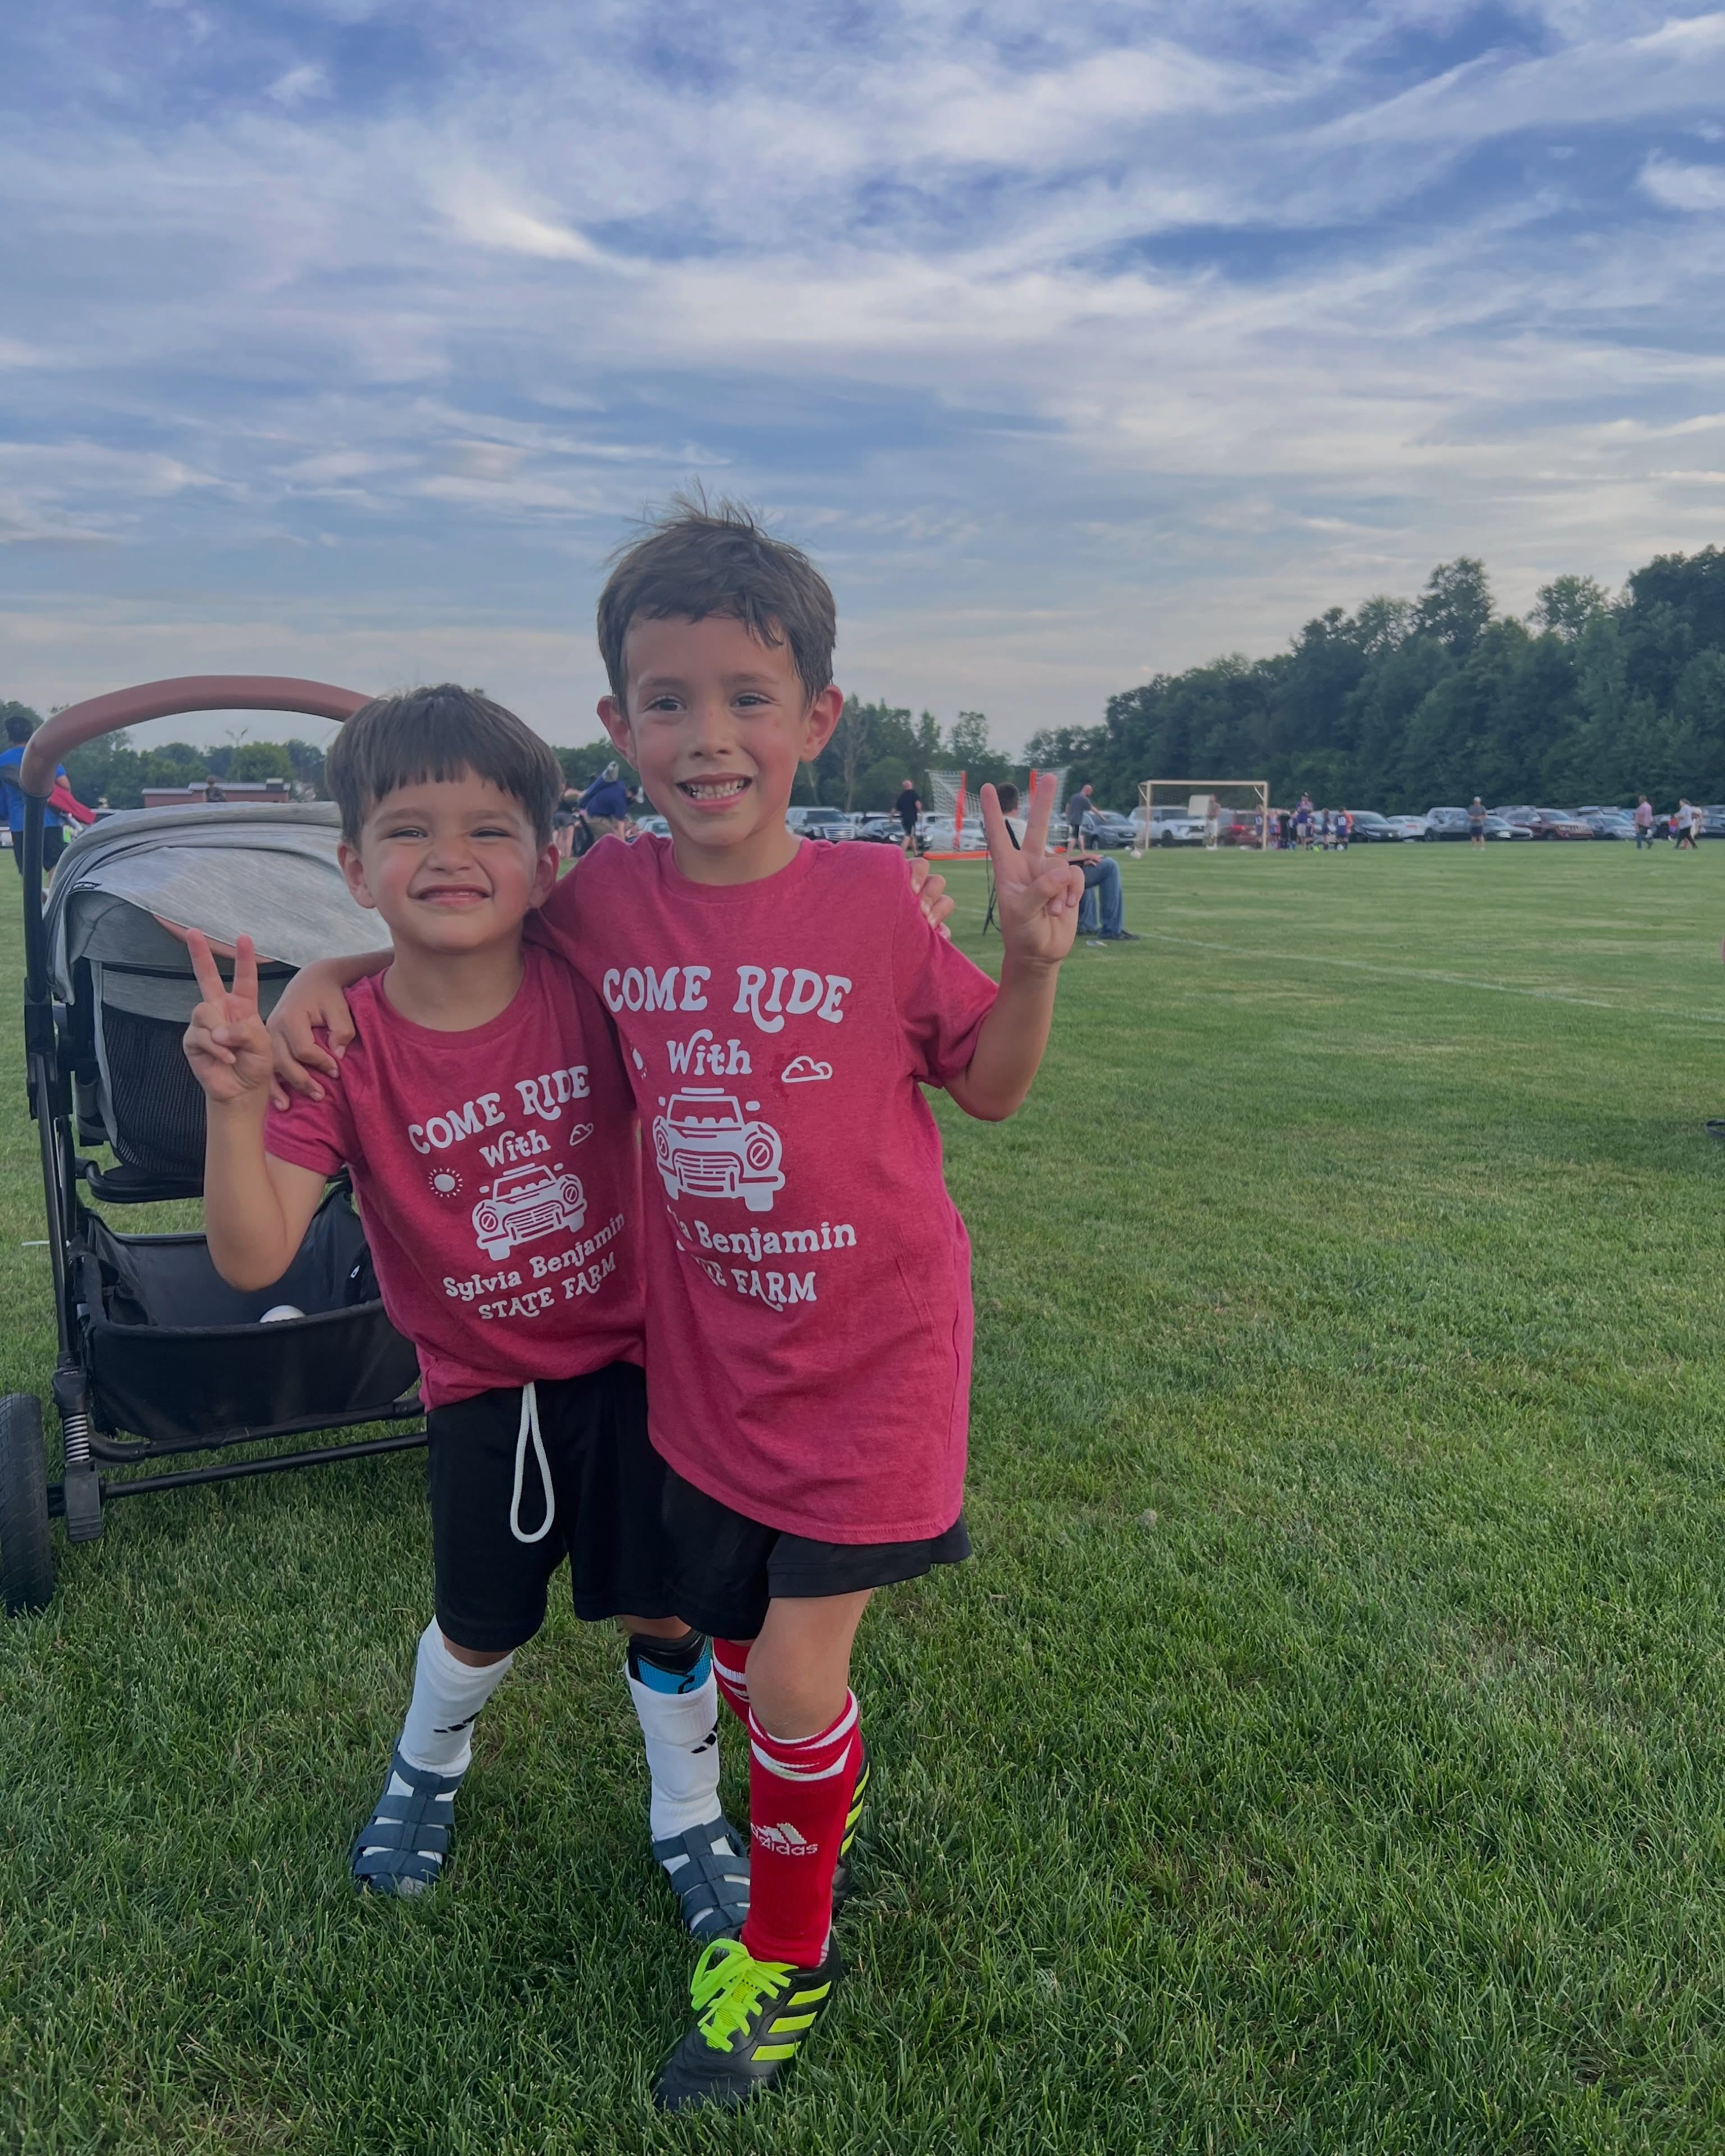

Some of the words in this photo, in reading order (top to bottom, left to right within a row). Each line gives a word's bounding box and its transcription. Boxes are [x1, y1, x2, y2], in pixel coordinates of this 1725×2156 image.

[603, 966, 711, 1012] COME
[732, 965, 852, 1034] RIDE
[666, 1029, 753, 1076] With
[408, 1092, 506, 1154] COME
[515, 1065, 591, 1121] RIDE
[479, 1130, 551, 1168] With
[442, 1270, 522, 1302] Sylvia
[529, 1212, 626, 1279] Benjamin
[693, 1220, 857, 1263] Benjamin
[478, 1287, 555, 1320] STATE
[562, 1251, 617, 1299] FARM
[731, 1268, 818, 1312] FARM
